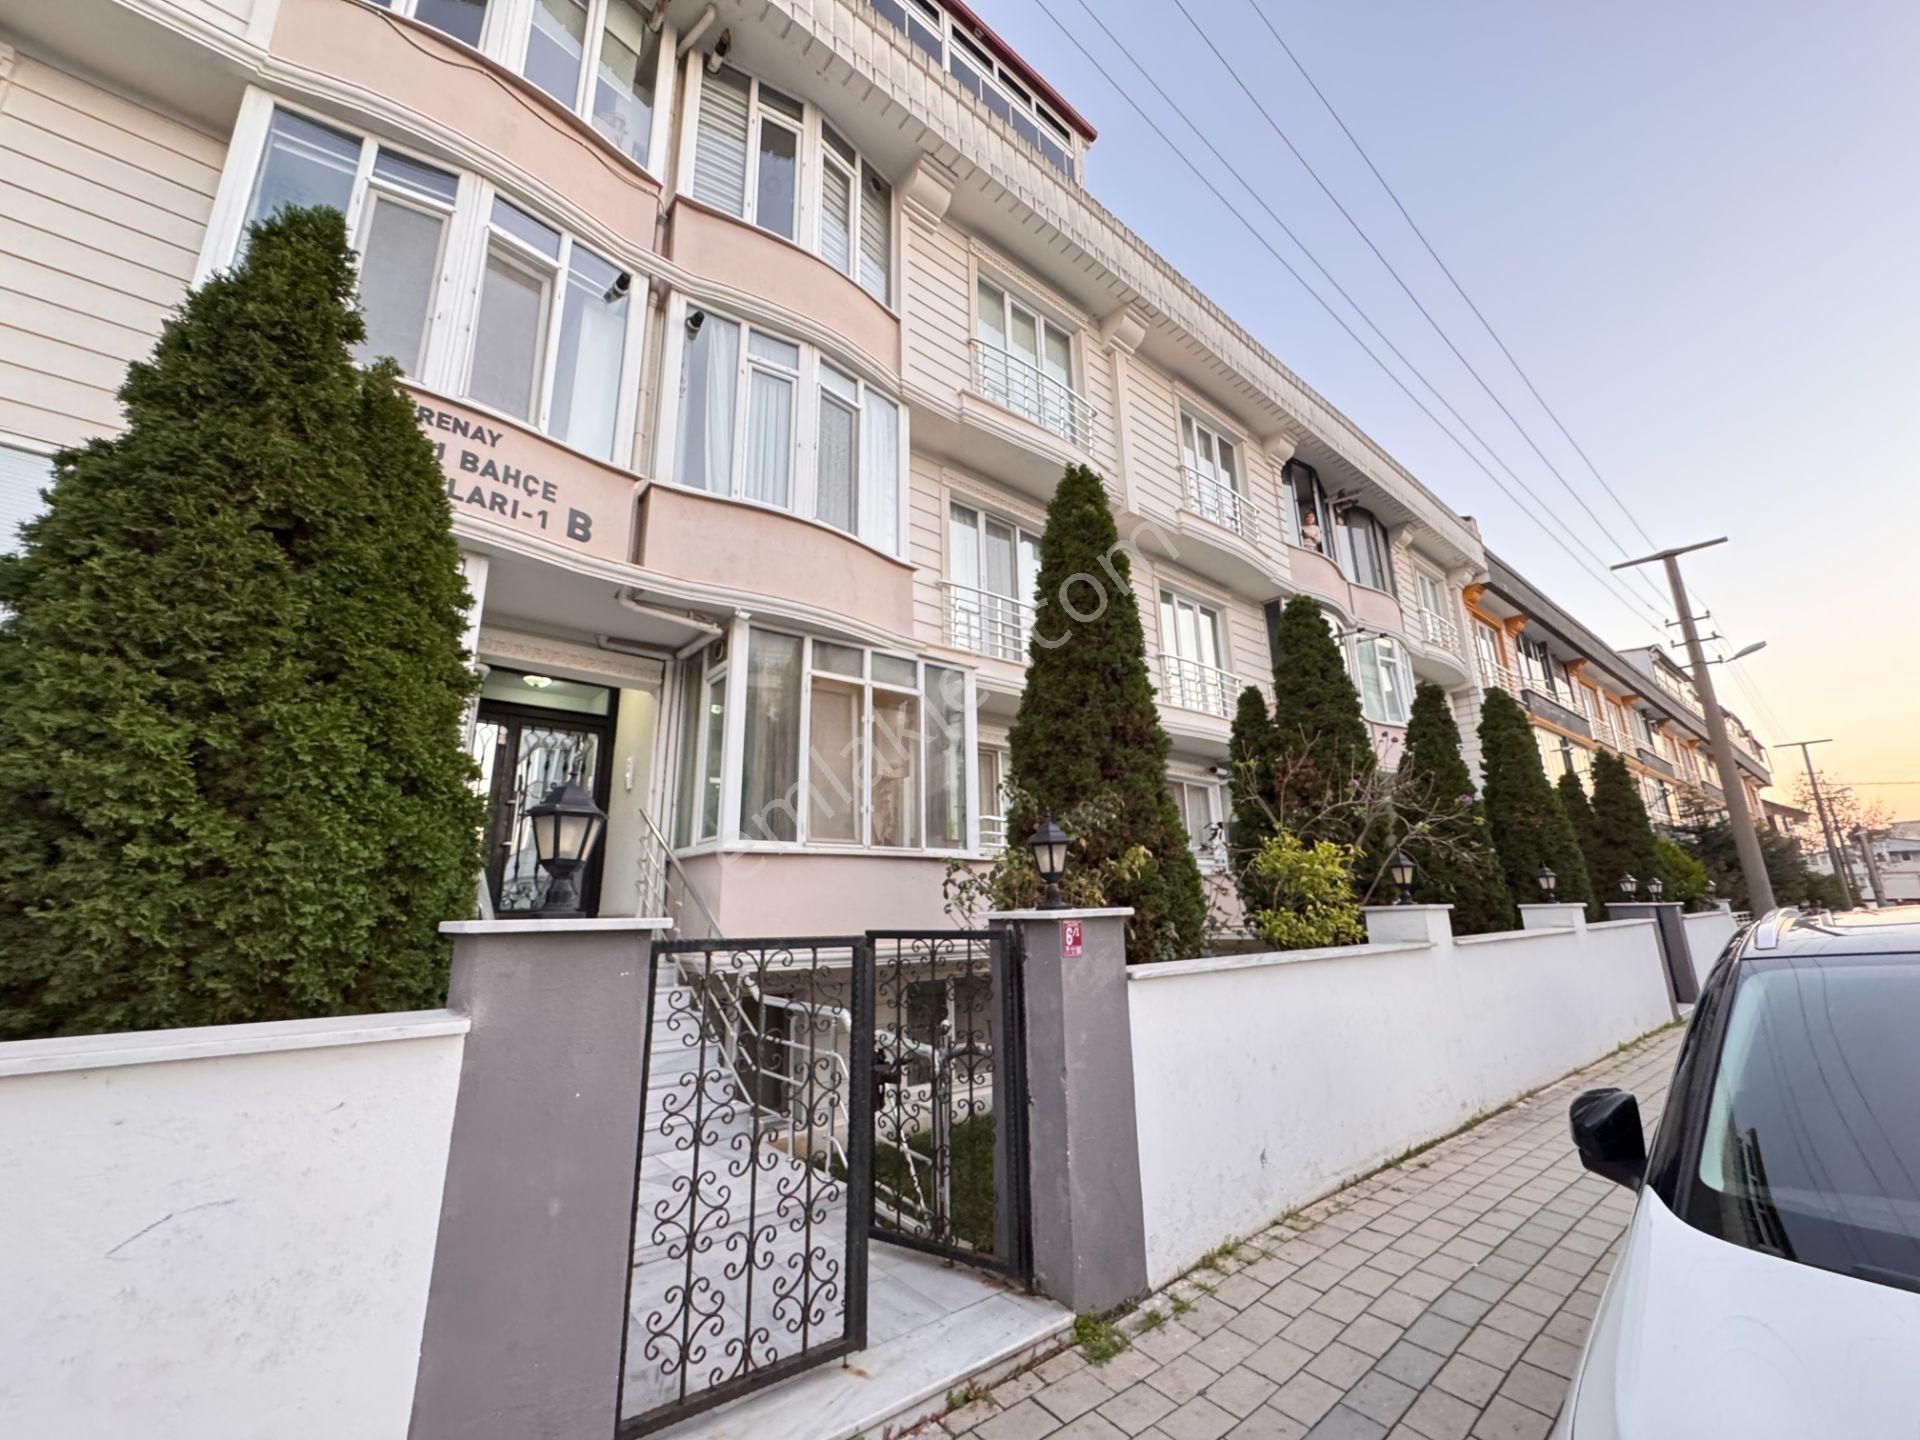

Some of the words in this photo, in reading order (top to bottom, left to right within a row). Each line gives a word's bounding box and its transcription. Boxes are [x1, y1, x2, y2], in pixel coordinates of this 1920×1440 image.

[418, 405, 503, 448] RENAY
[460, 449, 558, 503] BAHÇE
[447, 477, 548, 530] LARI-1
[566, 507, 593, 543] B
